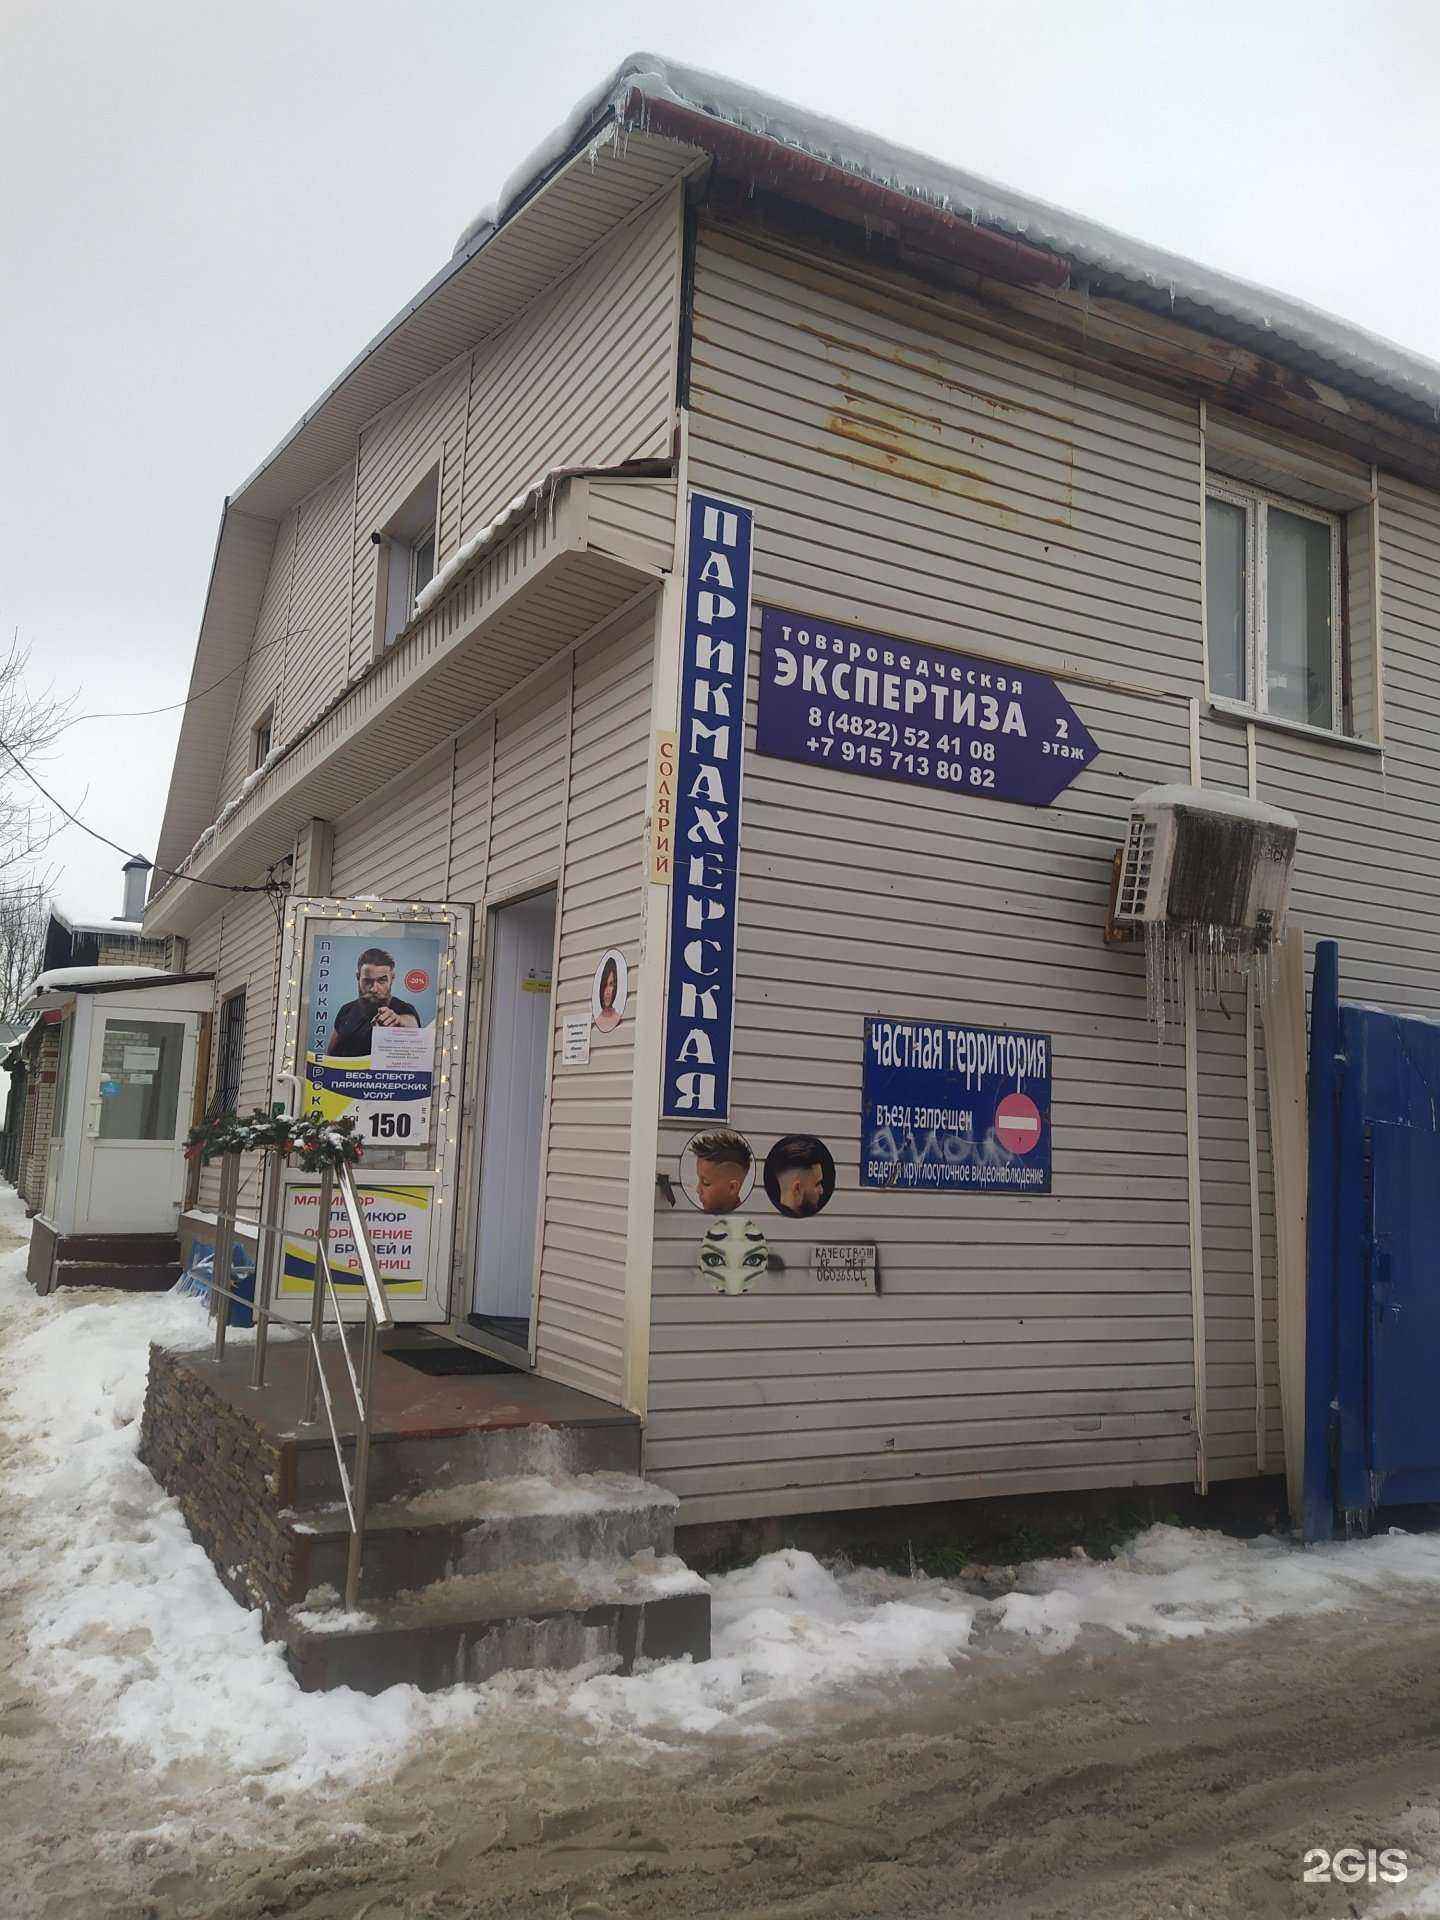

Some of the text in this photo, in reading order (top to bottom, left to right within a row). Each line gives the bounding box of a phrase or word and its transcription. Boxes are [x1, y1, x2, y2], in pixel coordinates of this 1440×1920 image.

[781, 625, 1024, 696] товароведческая
[772, 646, 1028, 739] ЭКСПЕРТИЗА
[807, 706, 996, 763] 8 (4822) 52 41 08
[1055, 718, 1069, 739] 2
[806, 736, 996, 789] +7 915 713 80 82
[1041, 740, 1086, 762] этаж
[656, 742, 674, 874] СОЛЯРИЙ
[674, 505, 738, 1111] ПАРИКМАХЕРСКАЯ
[310, 941, 331, 1121] ПАРИКМАХЕРСКА
[345, 1072, 415, 1081] ВЕСЬ СПЕКТР
[947, 1030, 1046, 1094] территория
[331, 1081, 428, 1091] ПАРИКМАХЕРСКИХ
[362, 1091, 396, 1100] УСЛУГ
[368, 1113, 412, 1138] 150
[876, 1104, 973, 1137] въезд запрещен
[904, 1163, 970, 1187] круглосуточное
[971, 1161, 1044, 1190] видеонаблюдение
[330, 1211, 407, 1222] ПЕИКЮР
[335, 1242, 412, 1254] БРЕЙ И
